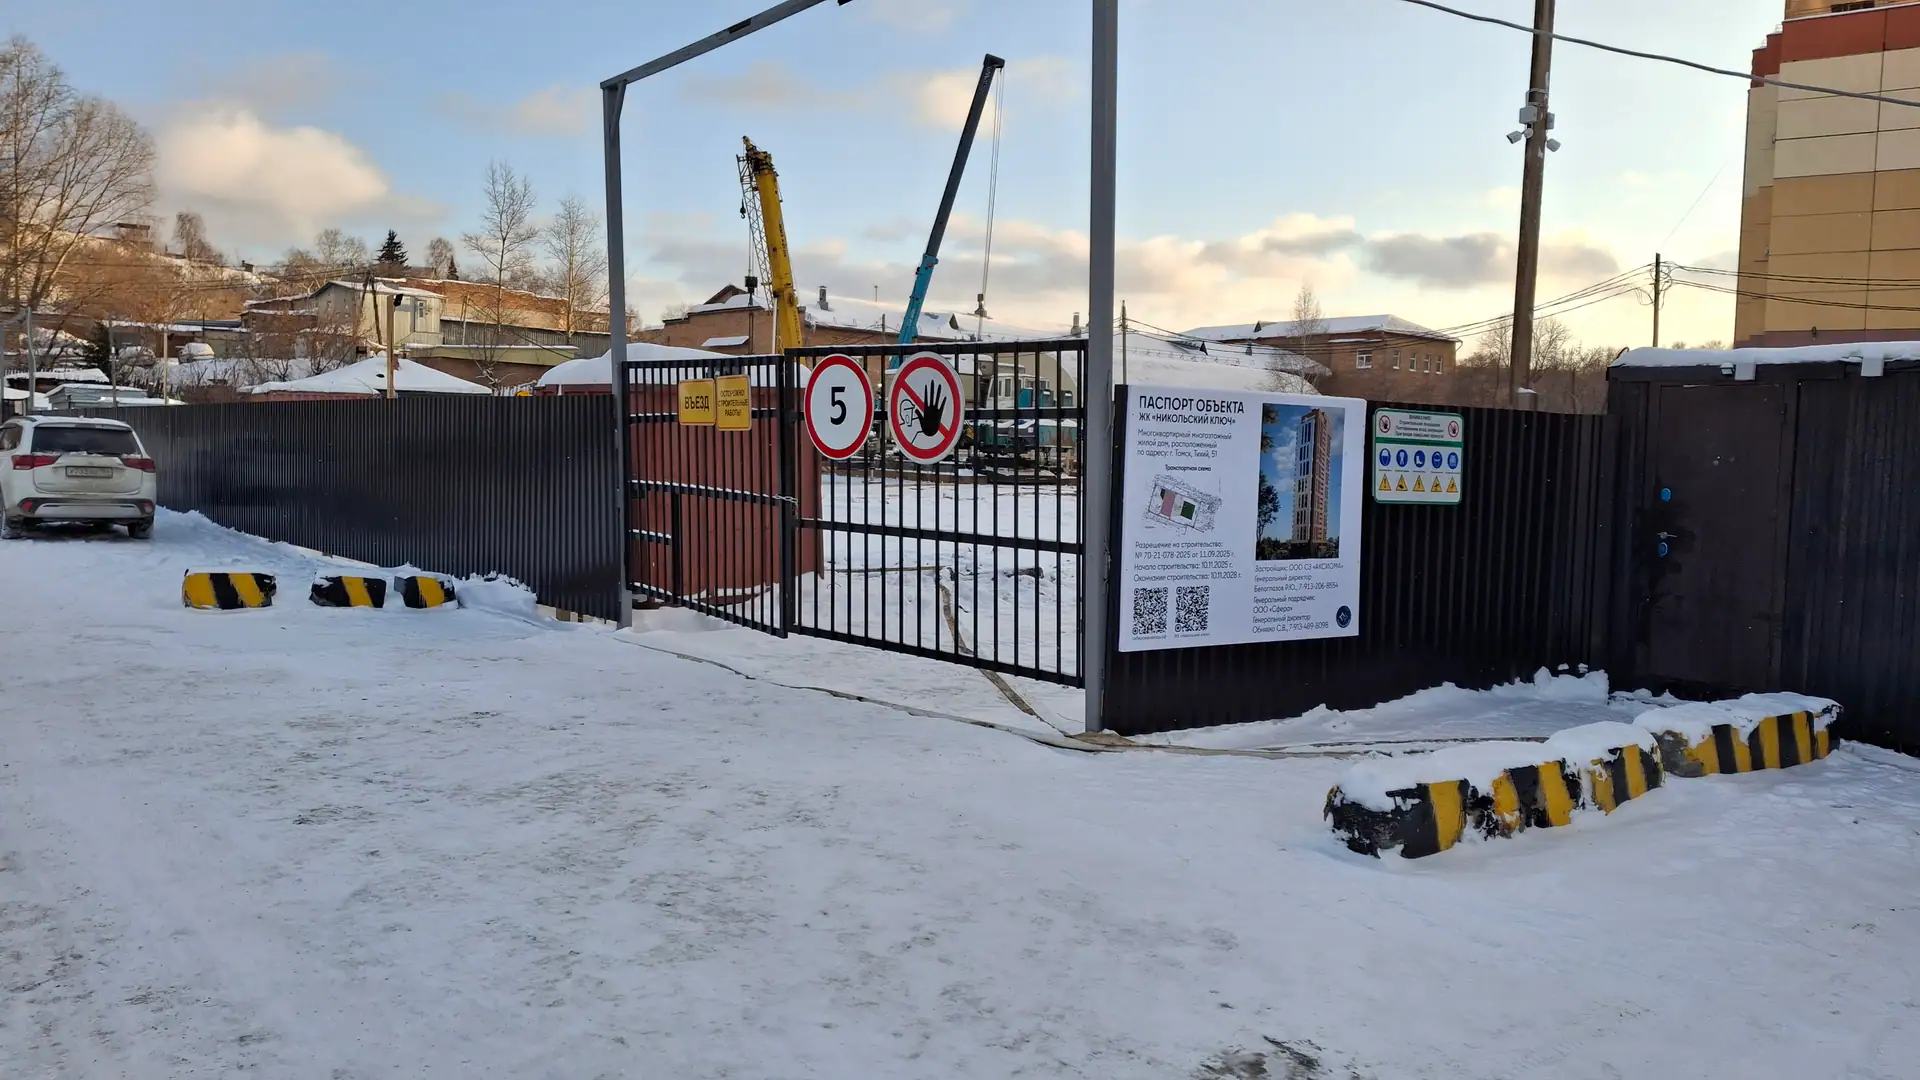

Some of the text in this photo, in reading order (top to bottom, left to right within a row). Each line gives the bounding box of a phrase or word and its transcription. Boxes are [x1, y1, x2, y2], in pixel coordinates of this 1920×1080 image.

[684, 396, 710, 412] ВЪЕЗД
[830, 386, 847, 426] 5
[1139, 396, 1244, 414] ПАСПОРТ ОБЪЕКТА
[1138, 412, 1236, 425] ЖК «НИКОЛЬСКИЙ КЛЮЧ»
[1138, 428, 1232, 440] Многоквартирный многоэтажный
[1137, 438, 1156, 446] жилой
[1171, 442, 1218, 450] расположенный
[1175, 449, 1192, 458] Томск,
[1136, 541, 1172, 550] Разрешение
[1144, 551, 1190, 560] 70-21-078-2025
[1200, 550, 1230, 558] 11.09.2025
[1201, 560, 1228, 569] 10.11.2025
[1134, 574, 1166, 582] Окончание
[1253, 605, 1292, 614] ООО «Сфера»
